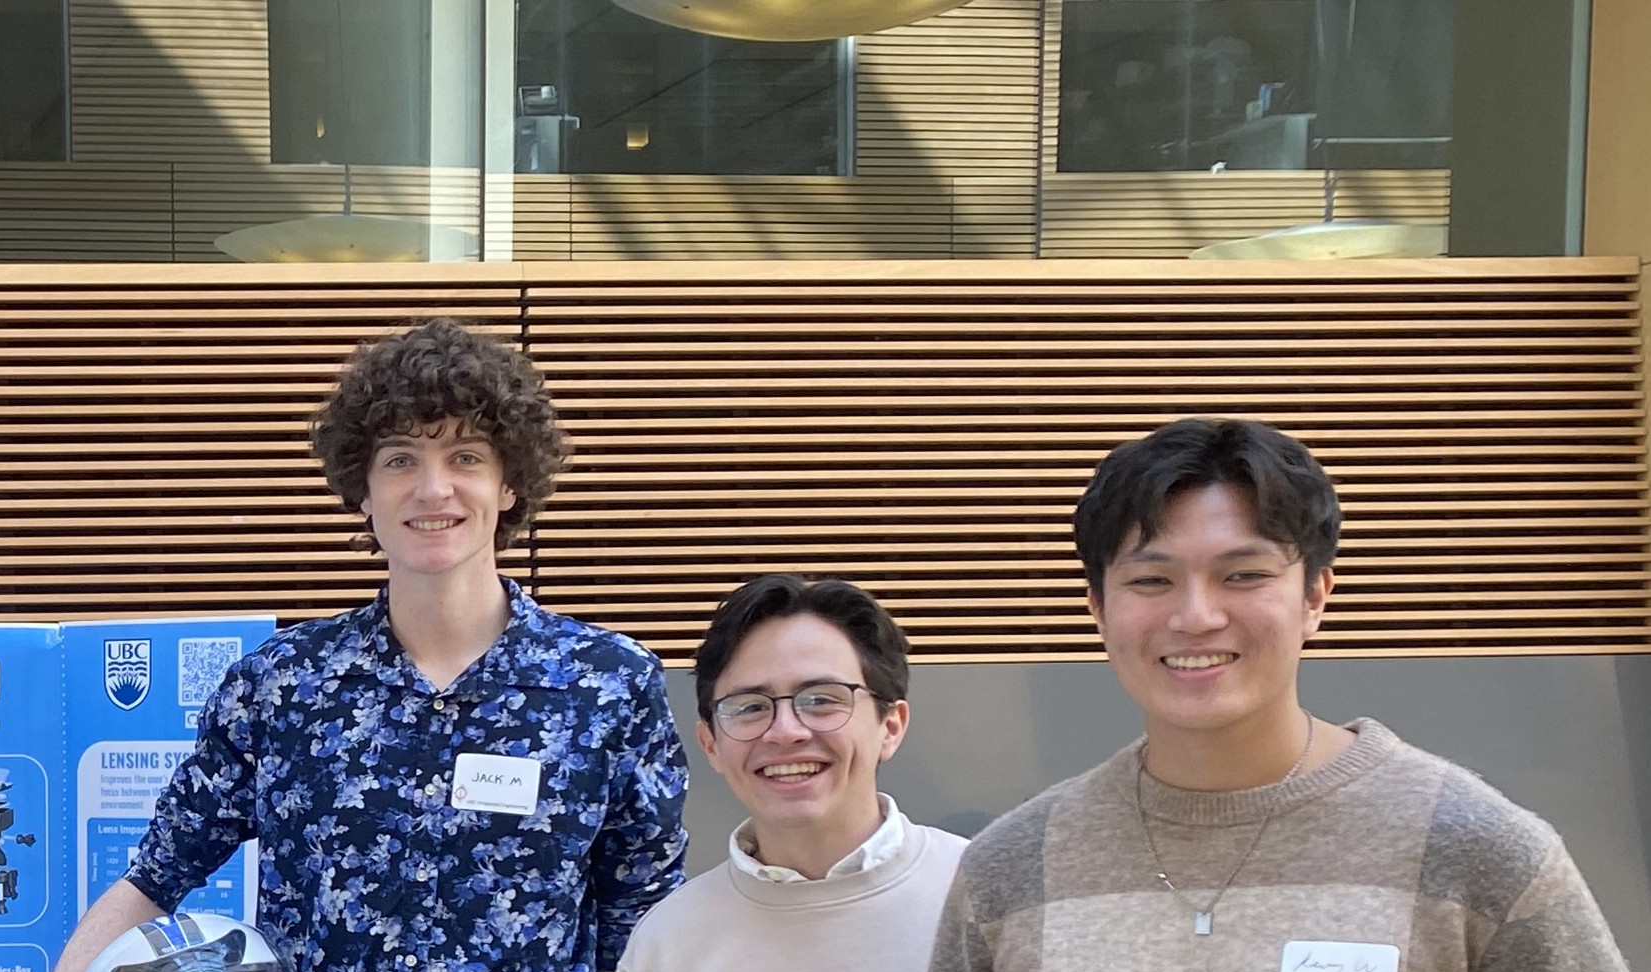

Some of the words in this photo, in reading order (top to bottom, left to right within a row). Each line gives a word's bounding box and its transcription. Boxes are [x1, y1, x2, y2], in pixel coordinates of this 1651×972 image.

[108, 642, 148, 660] UBC
[101, 752, 159, 769] LENSING
[471, 772, 504, 785] JACK
[509, 777, 522, 786] M
[98, 824, 117, 834] Lens
[120, 825, 149, 835] Impac
